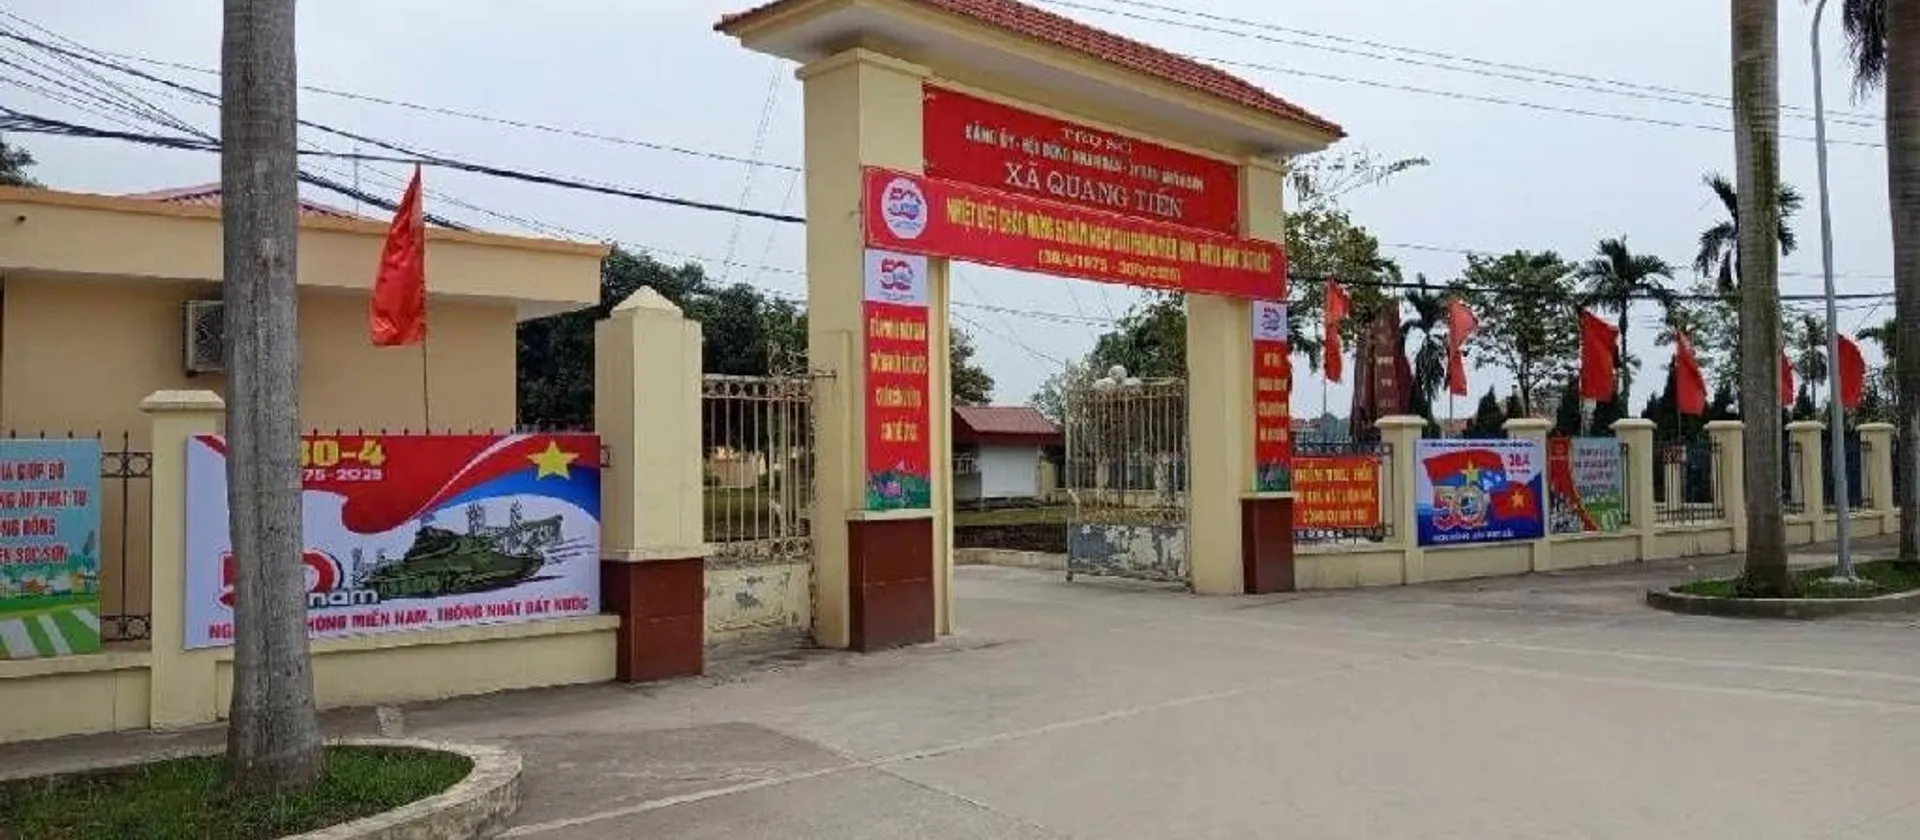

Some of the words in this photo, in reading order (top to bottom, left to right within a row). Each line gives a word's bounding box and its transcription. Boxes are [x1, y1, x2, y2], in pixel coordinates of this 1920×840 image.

[1005, 160, 1040, 190] XÃ
[1046, 170, 1128, 208] QUANG
[304, 467, 383, 482] 75-2025
[352, 607, 390, 628] MIỀN
[395, 608, 433, 625] NAM,
[437, 600, 483, 622] THỐNG
[487, 598, 521, 618] NHẤT
[526, 594, 551, 616] ĐẤT
